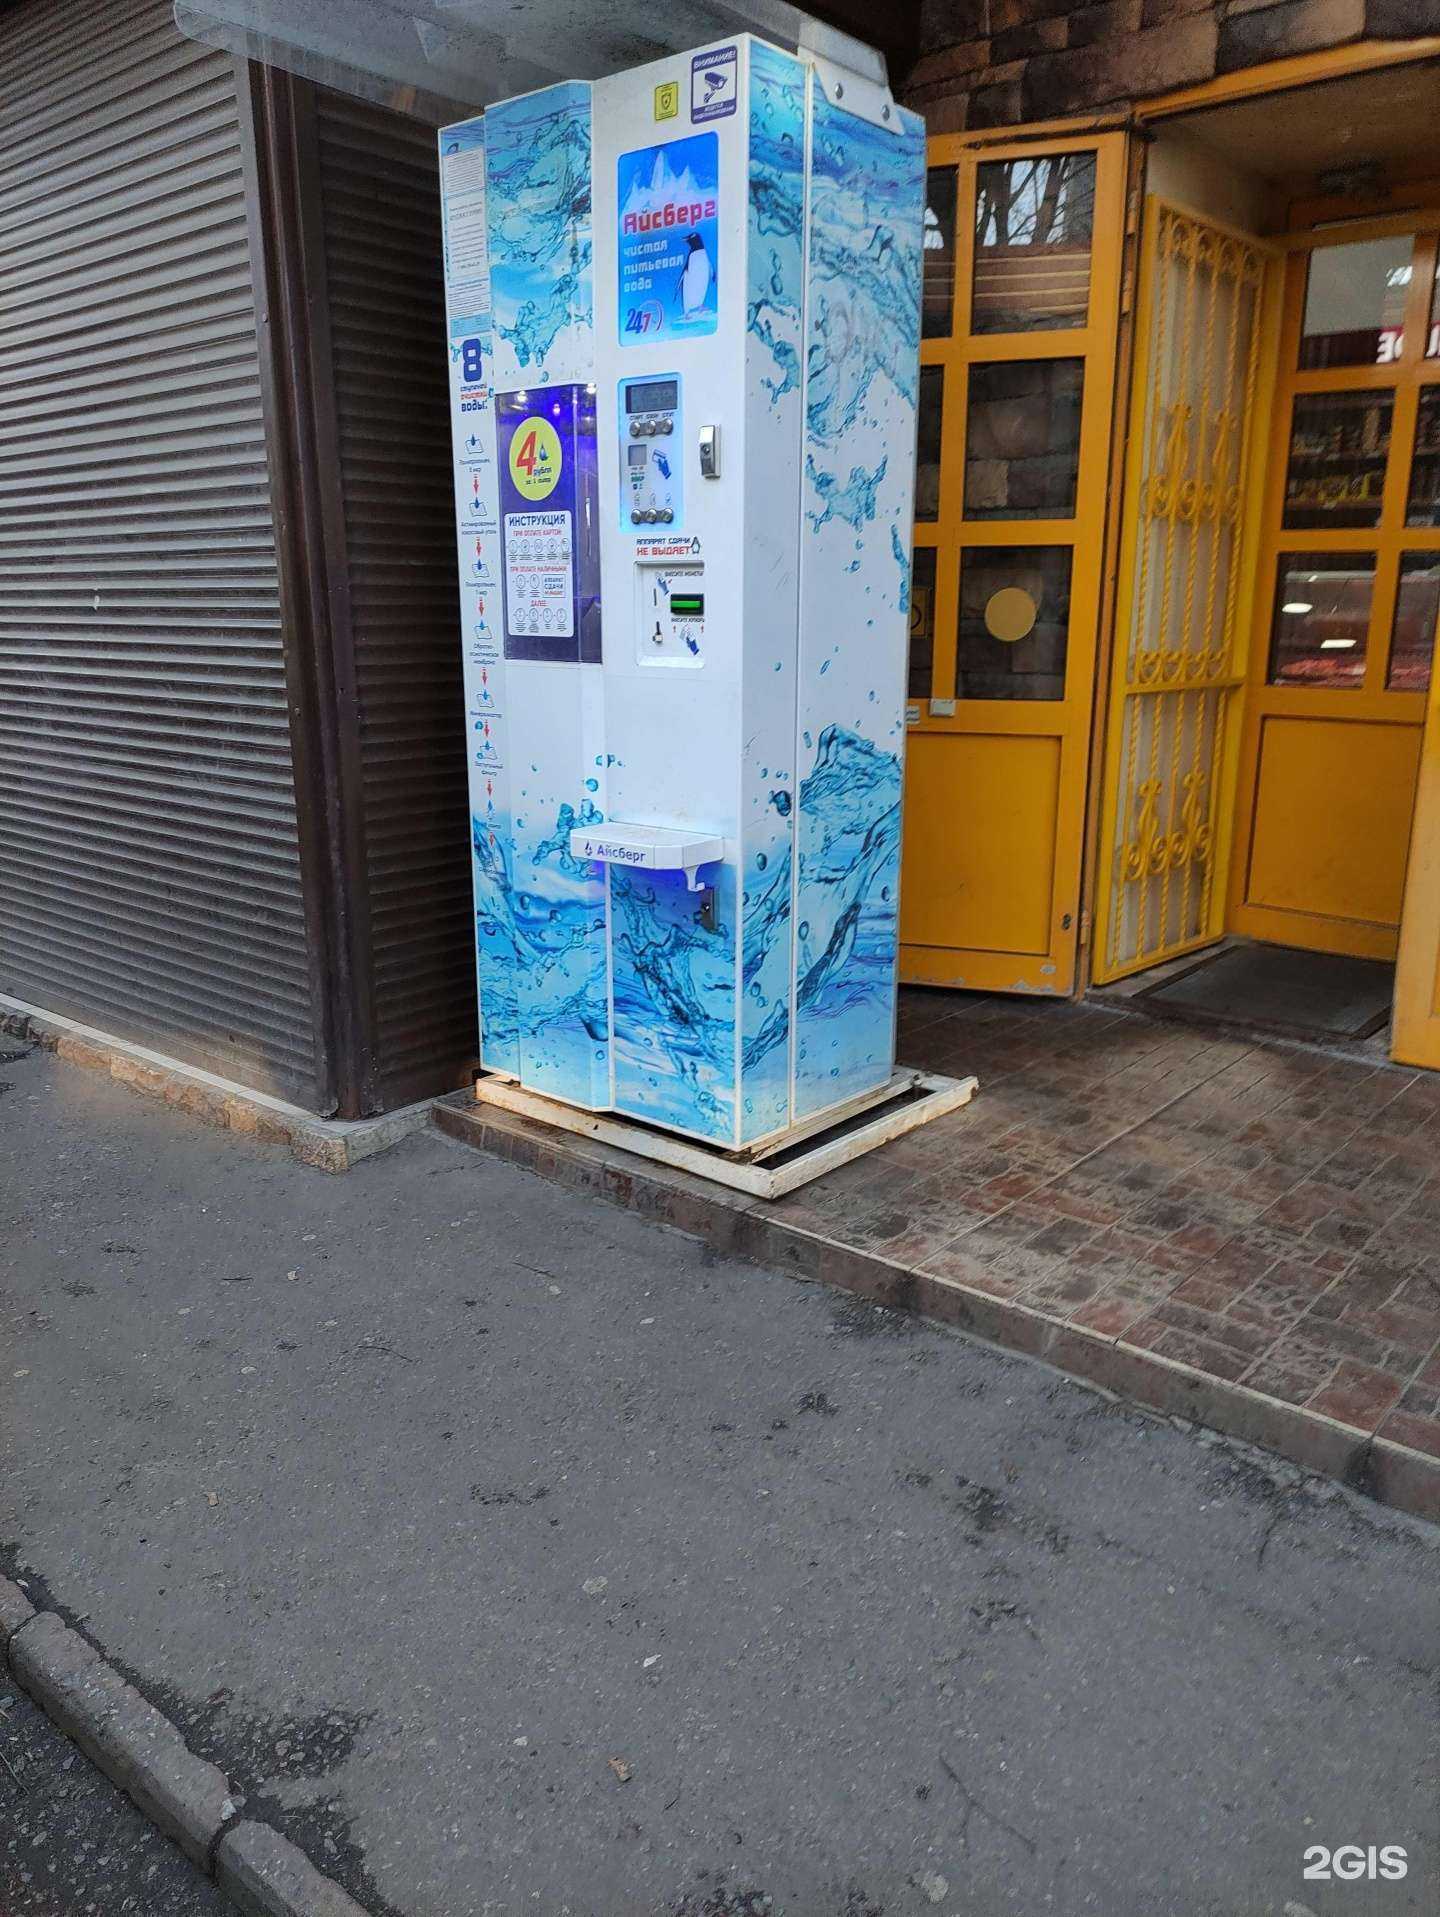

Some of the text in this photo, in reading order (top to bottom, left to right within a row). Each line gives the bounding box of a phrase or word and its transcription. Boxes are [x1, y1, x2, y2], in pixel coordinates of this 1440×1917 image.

[624, 200, 716, 235] Айсберг
[624, 240, 668, 257] чистая
[624, 255, 684, 275] питьевая
[624, 277, 653, 293] вода
[463, 338, 482, 382] 8
[516, 431, 537, 476] 4
[509, 514, 566, 527] ИНСТРУКЦИЯ
[637, 545, 690, 556] НЕ ВЫДАЕТ
[597, 844, 646, 864] Айсберг
